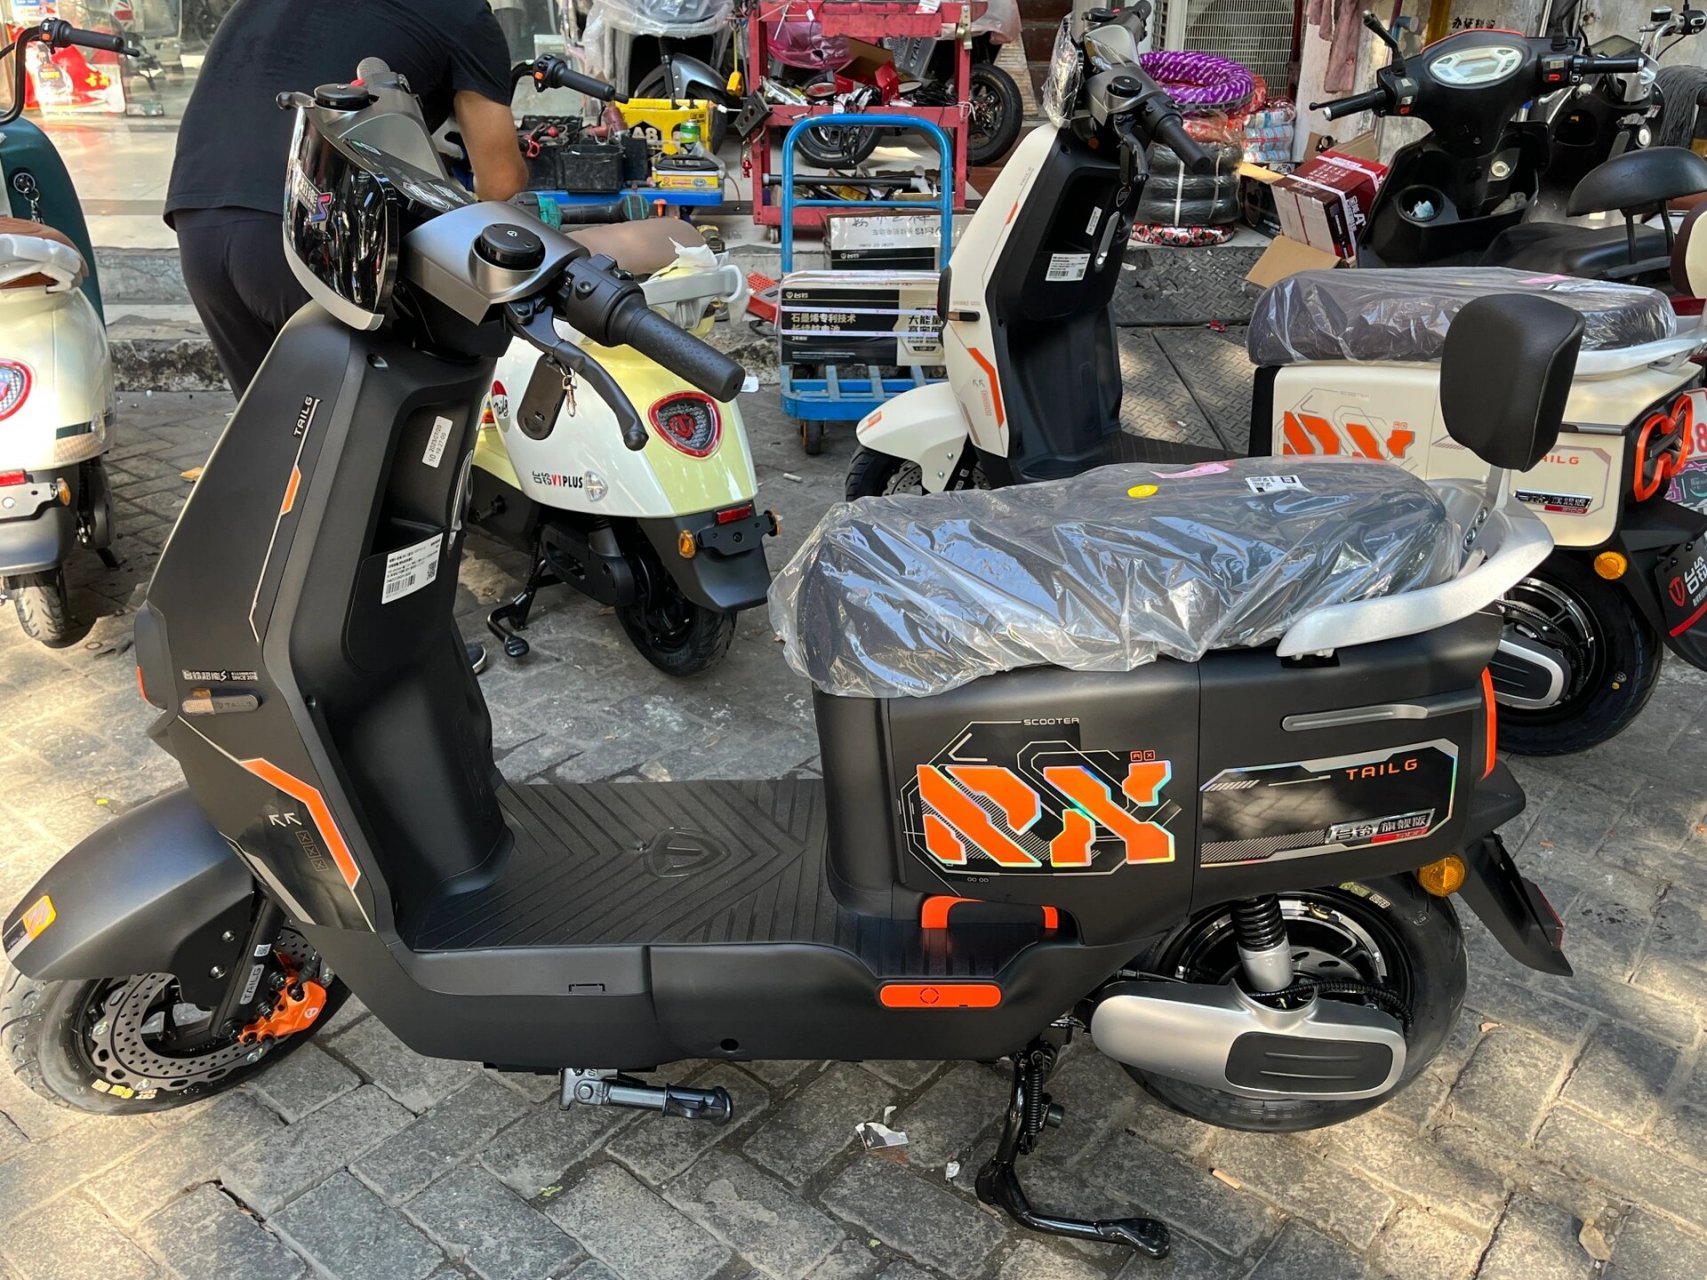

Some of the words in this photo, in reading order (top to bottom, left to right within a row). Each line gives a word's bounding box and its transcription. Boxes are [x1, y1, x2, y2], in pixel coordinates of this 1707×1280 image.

[293, 396, 313, 436] TAILG
[1023, 717, 1080, 726] SCOOTER
[1346, 758, 1418, 780] TAILG
[244, 967, 262, 1000] TAILG
